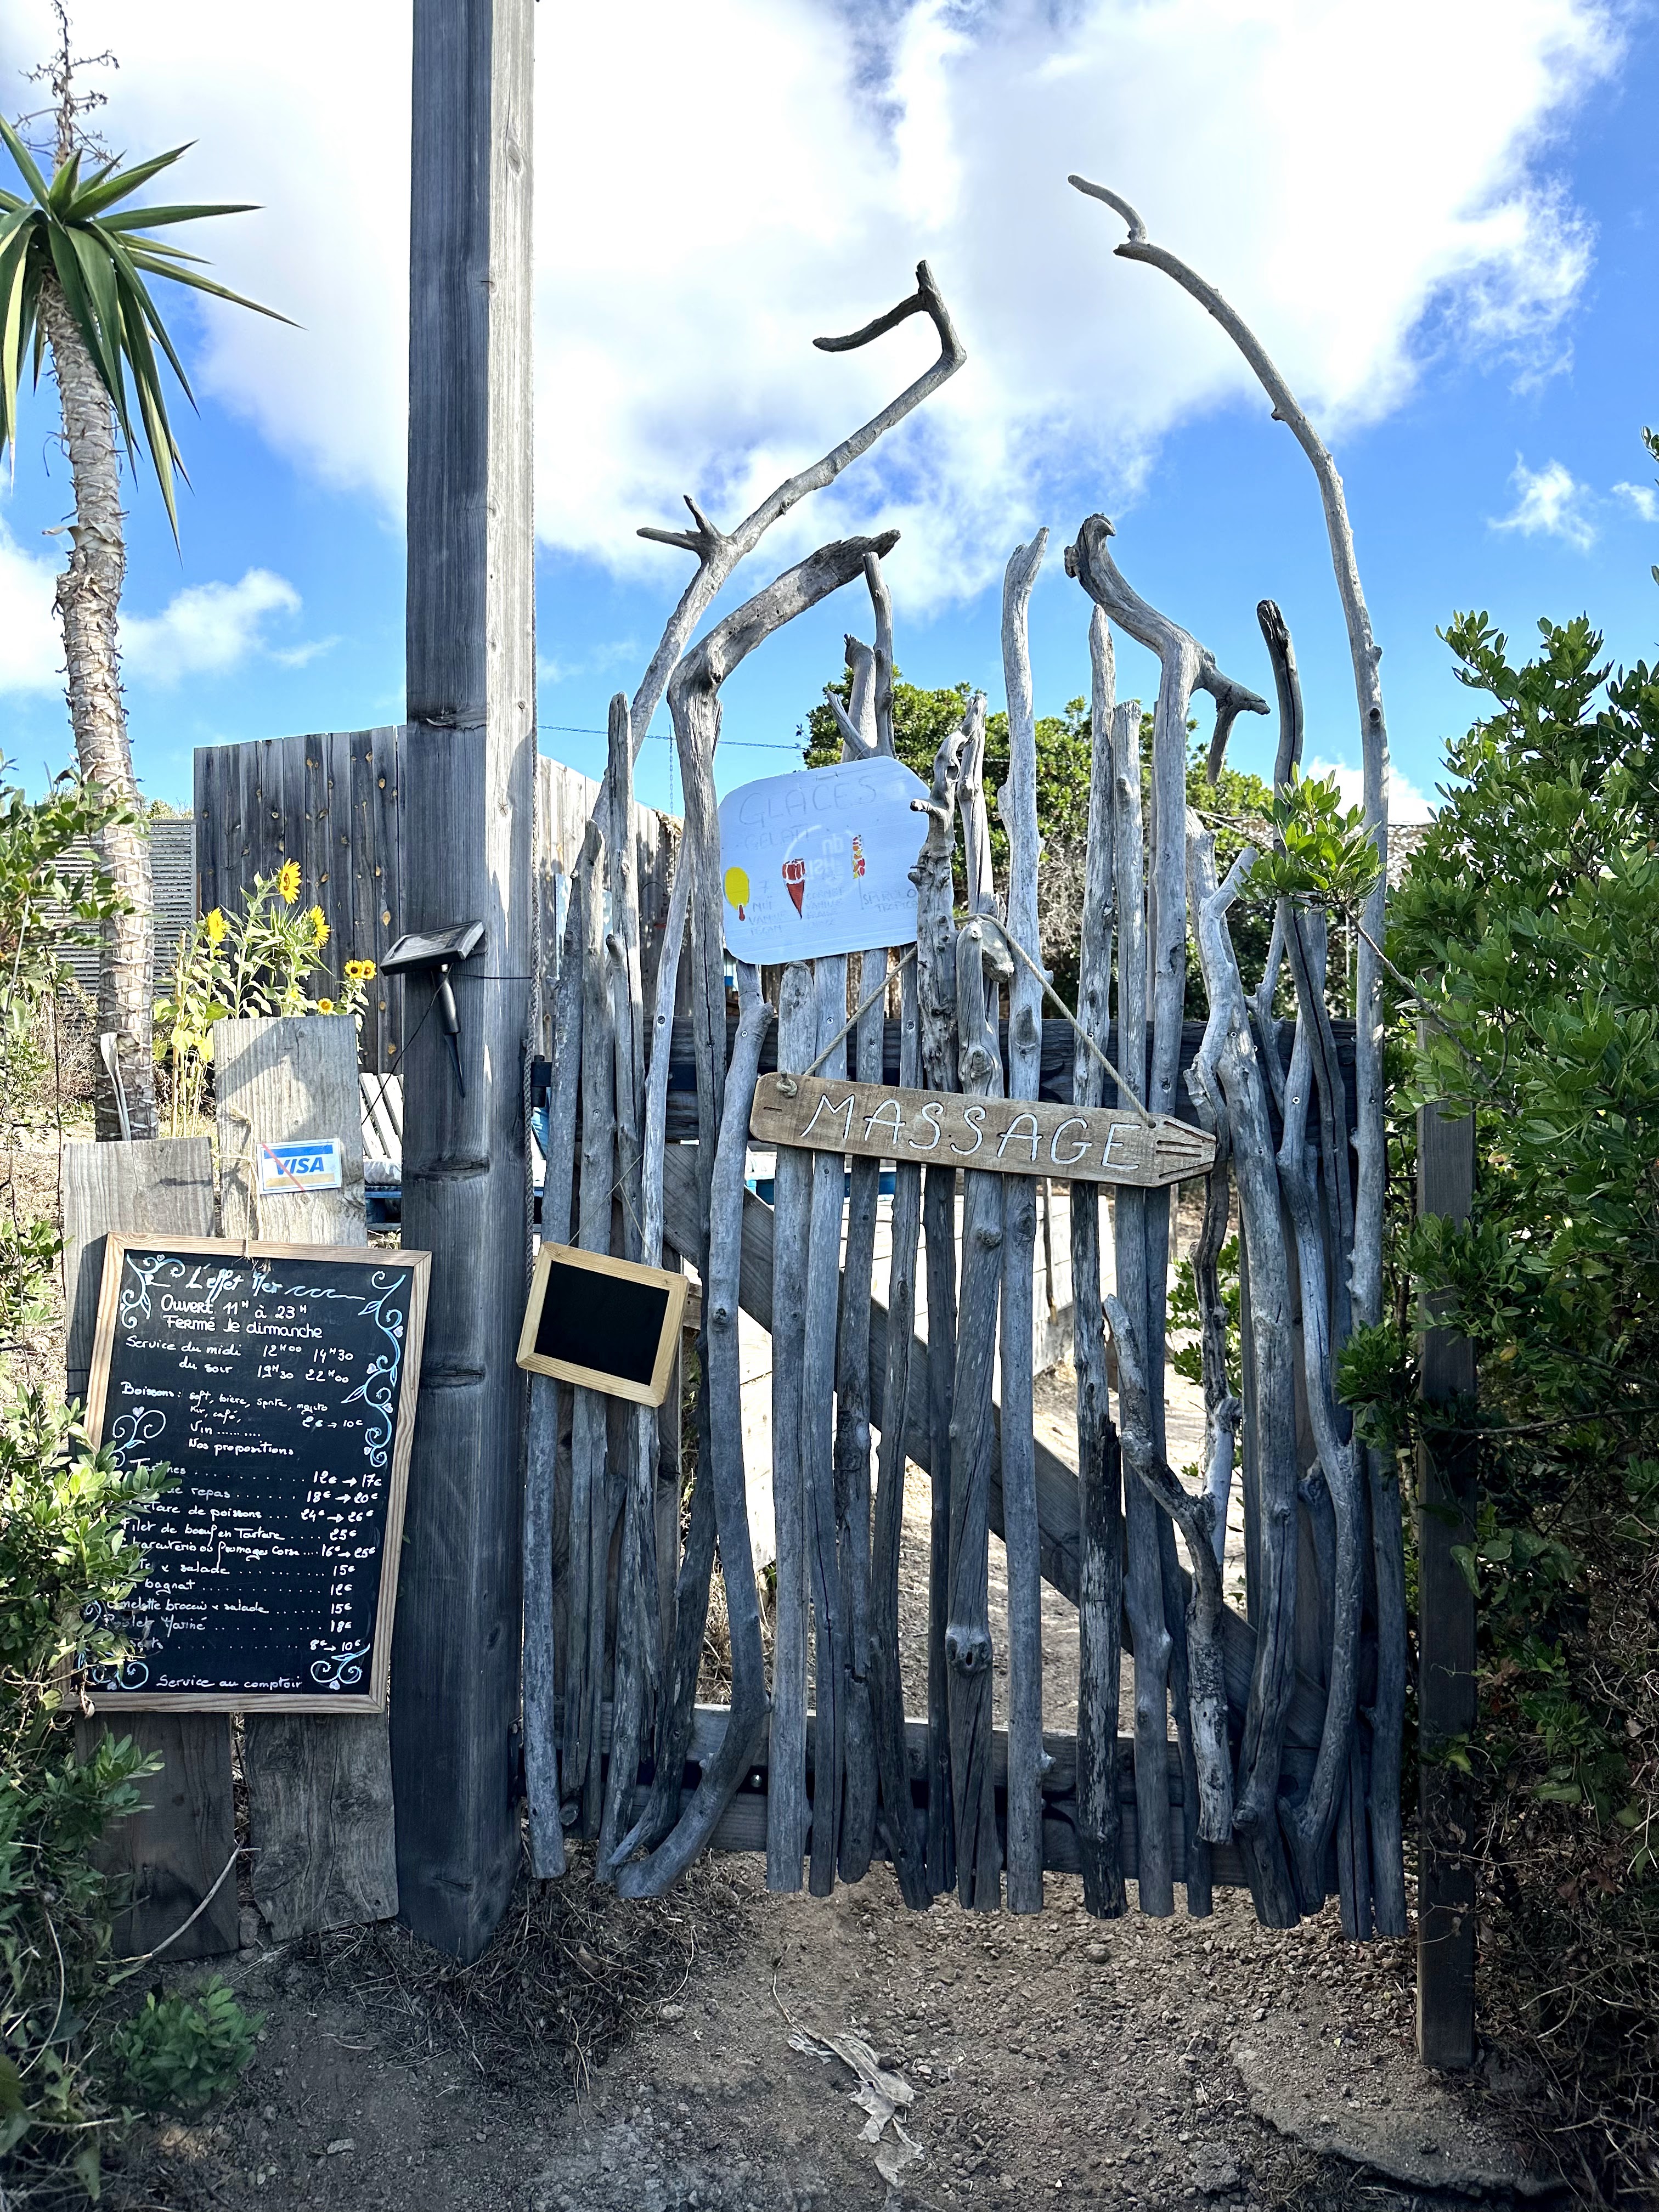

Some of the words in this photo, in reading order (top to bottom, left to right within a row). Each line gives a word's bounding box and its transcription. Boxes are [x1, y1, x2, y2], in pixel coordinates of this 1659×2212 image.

[738, 775, 877, 827] GLACES
[799, 1093, 1143, 1171] MASSAGE
[273, 1156, 325, 1176] VISA
[161, 1293, 214, 1314] Ouvert
[254, 1304, 267, 1319] à
[162, 1314, 216, 1331] Fermé
[246, 1321, 323, 1339] dimanche
[125, 1334, 177, 1351] Service
[180, 1340, 202, 1353] du
[206, 1344, 242, 1356] midi
[179, 1355, 198, 1370] du
[213, 1440, 295, 1457] propositions
[190, 1487, 231, 1502] repas
[188, 1505, 206, 1516] de
[160, 1522, 178, 1534] de
[144, 1578, 196, 1596] bagnat
[155, 1674, 216, 1688] Service
[218, 1679, 240, 1688] au
[243, 1675, 302, 1691] comptoir
